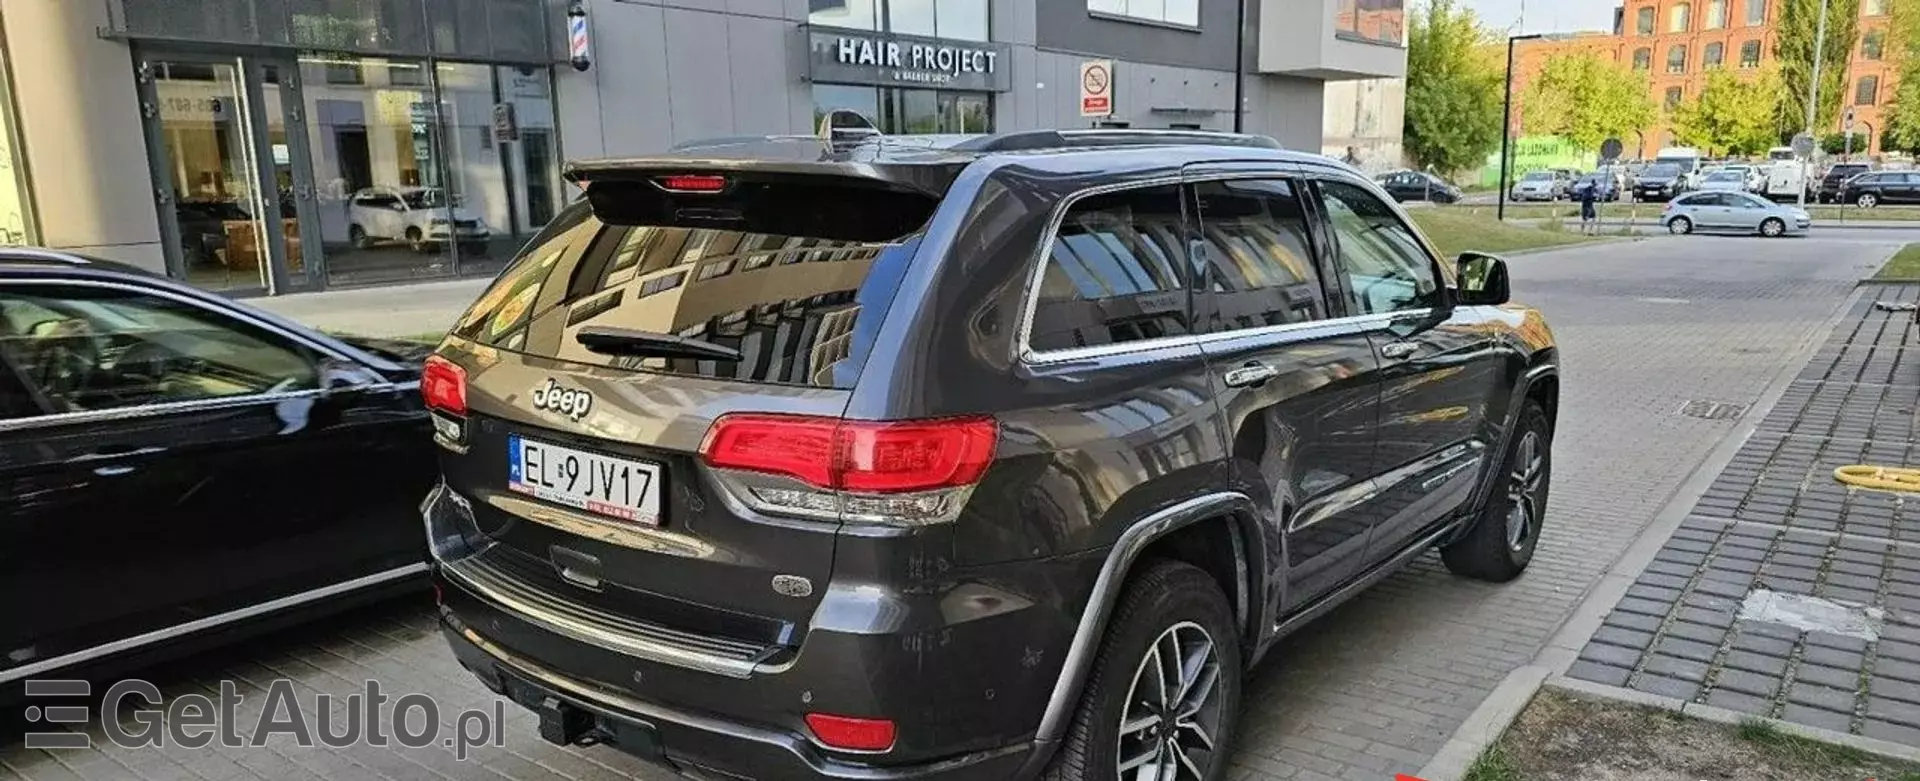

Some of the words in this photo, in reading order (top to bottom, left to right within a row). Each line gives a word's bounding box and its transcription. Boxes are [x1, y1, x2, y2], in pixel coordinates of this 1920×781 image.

[838, 37, 901, 67] HAIR
[912, 45, 997, 77] PROJECT
[533, 377, 592, 422] Jeep
